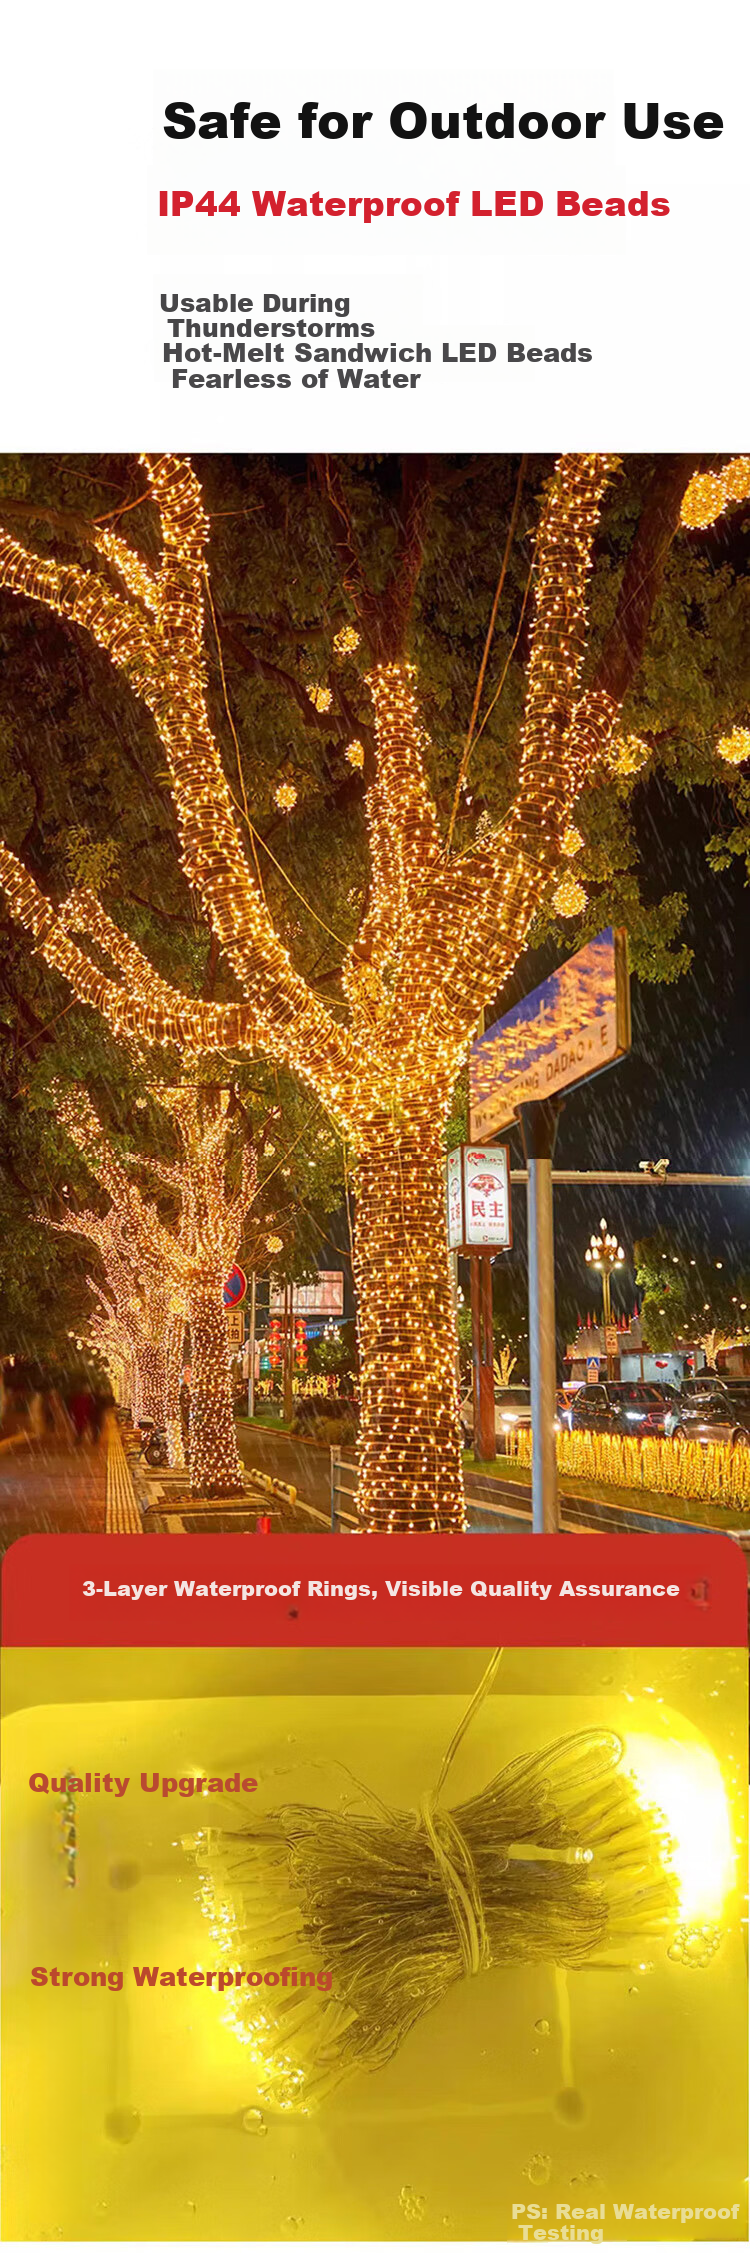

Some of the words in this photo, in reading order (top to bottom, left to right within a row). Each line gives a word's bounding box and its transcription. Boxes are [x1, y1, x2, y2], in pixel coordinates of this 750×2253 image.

[546, 1041, 584, 1081] DADAO
[600, 1024, 608, 1047] E
[471, 1200, 504, 1218] 民主
